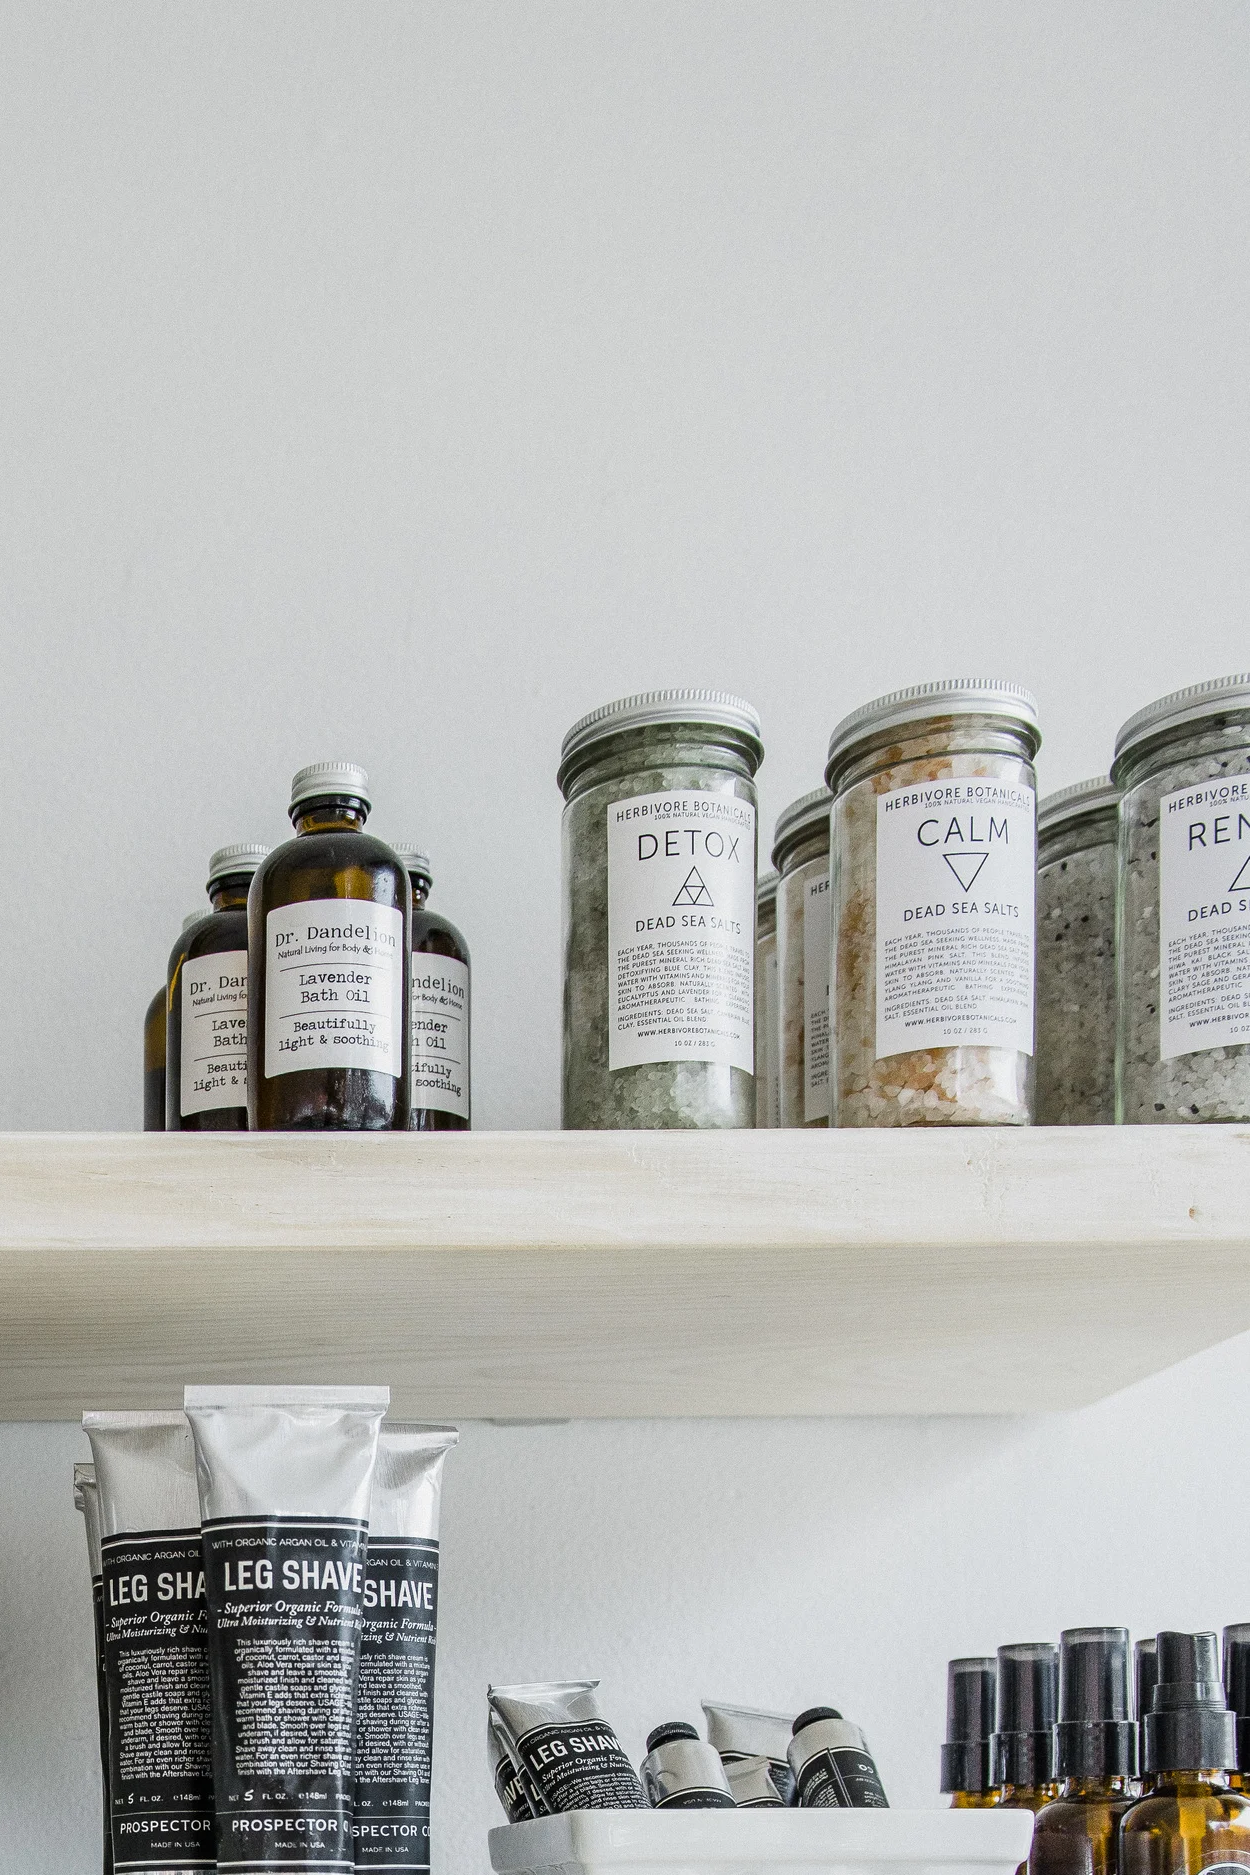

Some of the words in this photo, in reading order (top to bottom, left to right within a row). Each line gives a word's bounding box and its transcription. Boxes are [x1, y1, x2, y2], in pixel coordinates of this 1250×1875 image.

[885, 788, 961, 812] HERBIVORE
[967, 787, 1030, 807] BOTANICALS
[1169, 784, 1248, 813] HERBIVORE
[616, 800, 689, 822] HERBIVORE
[917, 816, 1009, 847] CALM
[638, 829, 740, 863] DETOX
[903, 904, 946, 922] DEAD
[952, 902, 978, 914] SEA
[984, 902, 1019, 918] SALTS
[1188, 902, 1232, 922] DEAD
[635, 915, 676, 933] DEAD
[681, 915, 706, 927] SEA
[710, 916, 741, 934] SALTS
[275, 931, 299, 948] Dr.
[307, 924, 396, 947] Dandelion
[299, 971, 373, 987] Lavender
[300, 989, 339, 1004] Bath
[346, 990, 370, 1003] Oil
[293, 1018, 377, 1034] Beautifully
[278, 1035, 314, 1052] light
[319, 1034, 328, 1045] &
[333, 1034, 389, 1053] soothing
[235, 1538, 277, 1547] ORGANIC
[279, 1538, 312, 1547] ARGAN
[314, 1538, 329, 1547] OIL
[224, 1559, 273, 1592] LEG
[282, 1559, 363, 1594] SHAVE
[110, 1574, 148, 1607] LEG
[363, 1579, 433, 1610] SHAVE
[224, 1602, 272, 1617] Superior
[275, 1600, 321, 1616] Organic
[241, 1615, 303, 1628] Moisturizing
[120, 1819, 211, 1834] PROSPECTOR
[232, 1819, 338, 1832] PROSPECTOR
